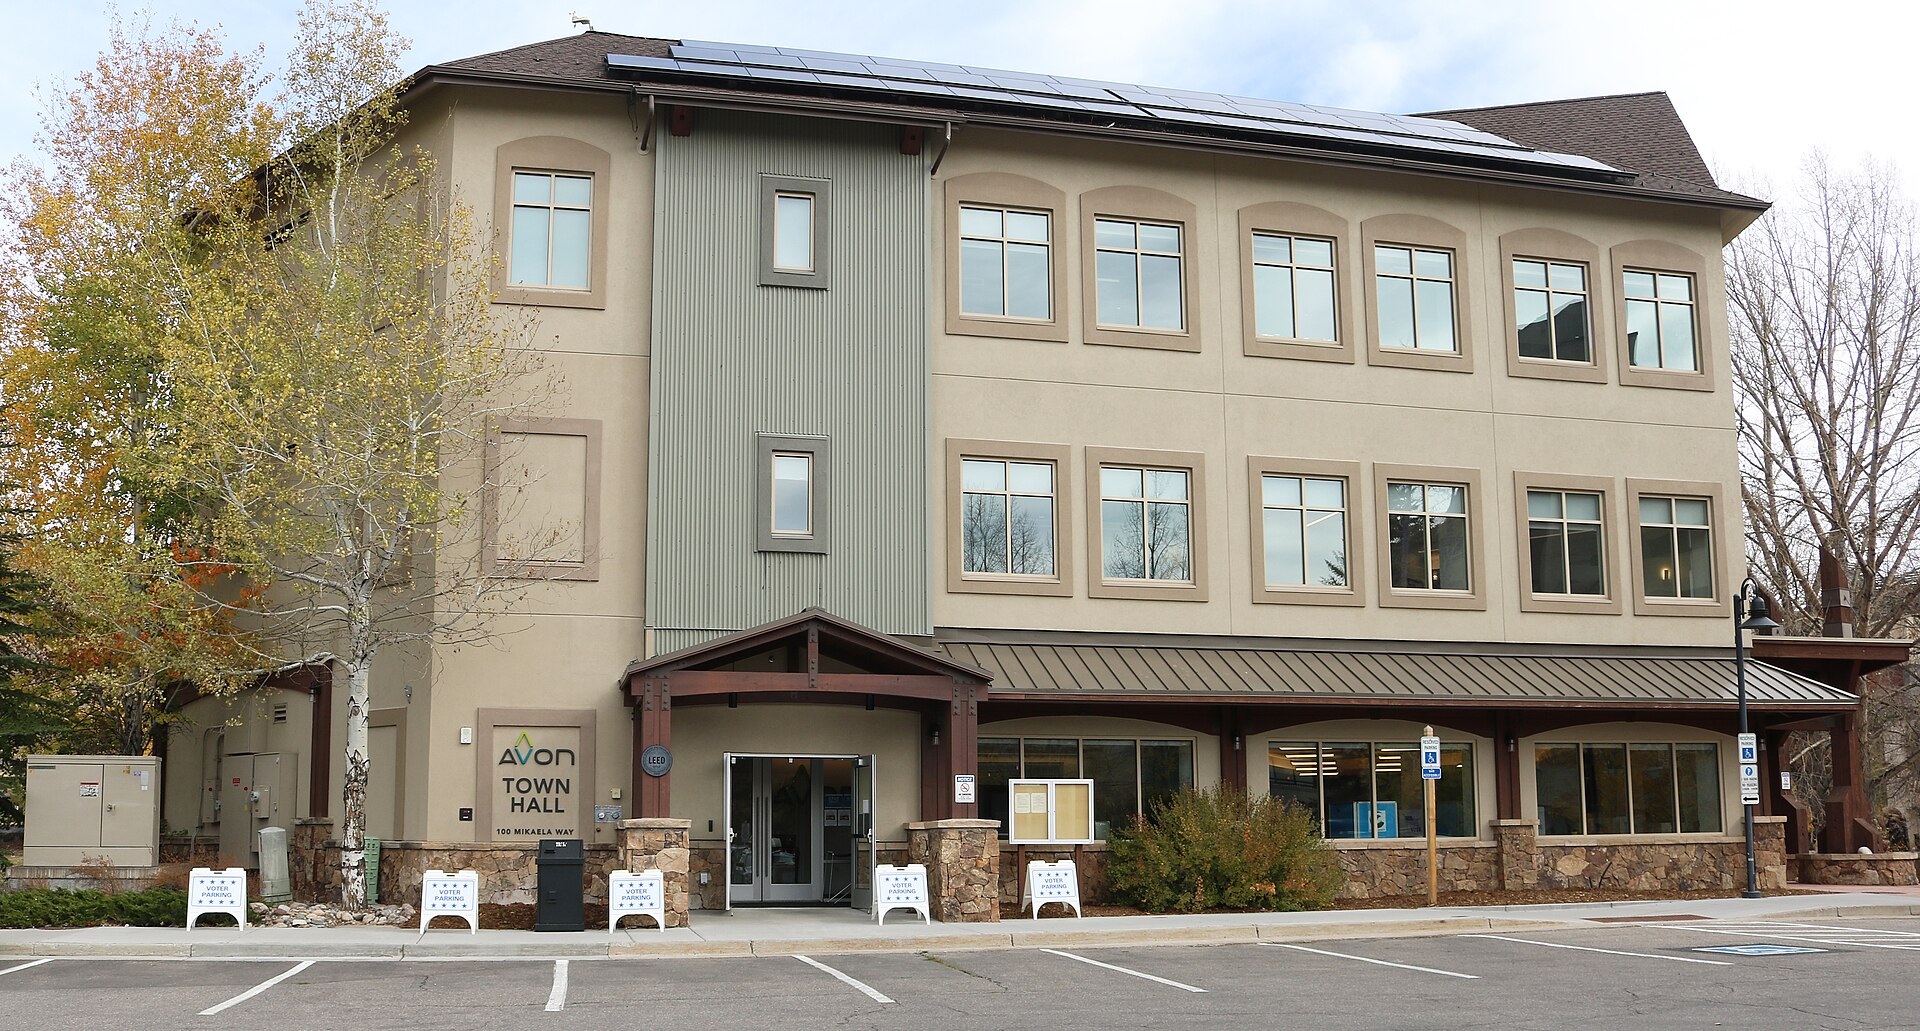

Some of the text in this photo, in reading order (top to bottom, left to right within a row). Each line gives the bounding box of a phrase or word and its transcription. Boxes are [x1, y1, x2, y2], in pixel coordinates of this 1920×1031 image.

[648, 756, 666, 765] LEED
[502, 778, 570, 794] TOWN
[511, 797, 565, 813] HALL
[514, 828, 552, 836] MIKAELA
